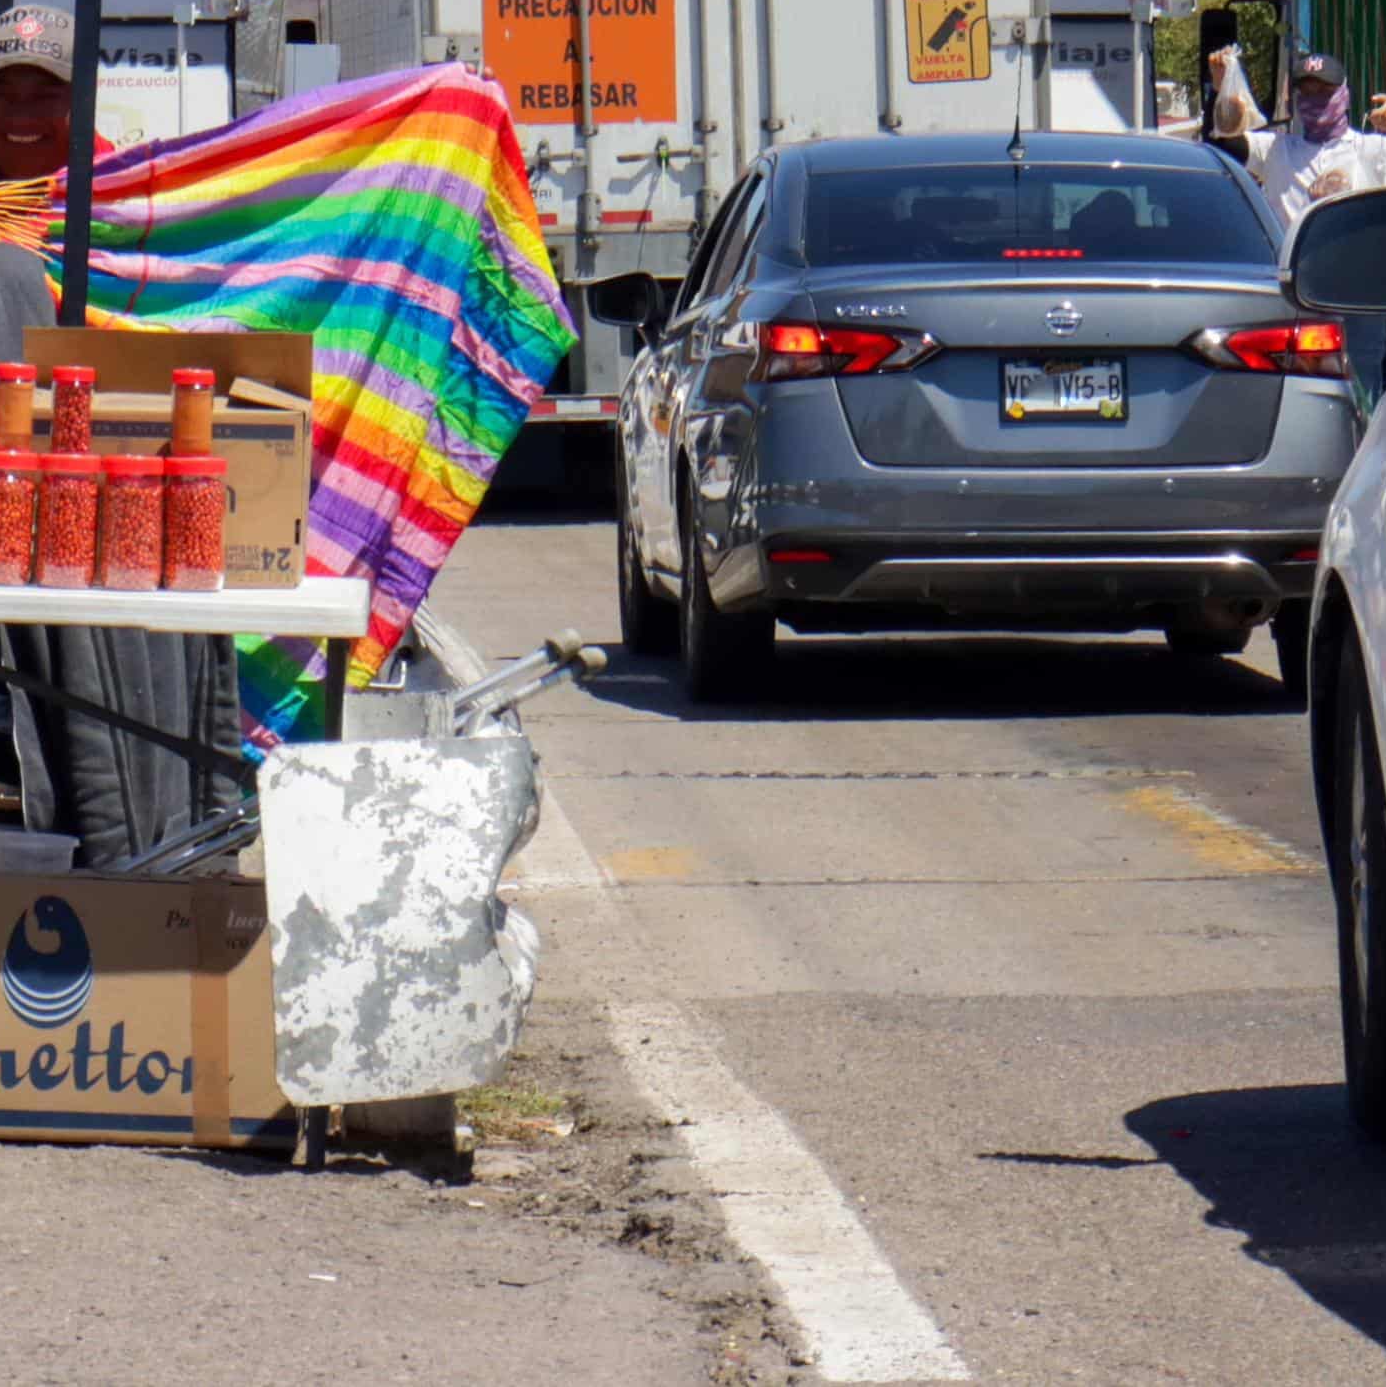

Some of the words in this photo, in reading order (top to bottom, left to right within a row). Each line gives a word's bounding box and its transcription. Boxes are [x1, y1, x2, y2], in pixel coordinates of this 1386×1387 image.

[563, 37, 595, 63] A
[1051, 42, 1133, 68] iaje
[916, 54, 966, 66] VUELTA
[916, 69, 966, 81] AMPLIA
